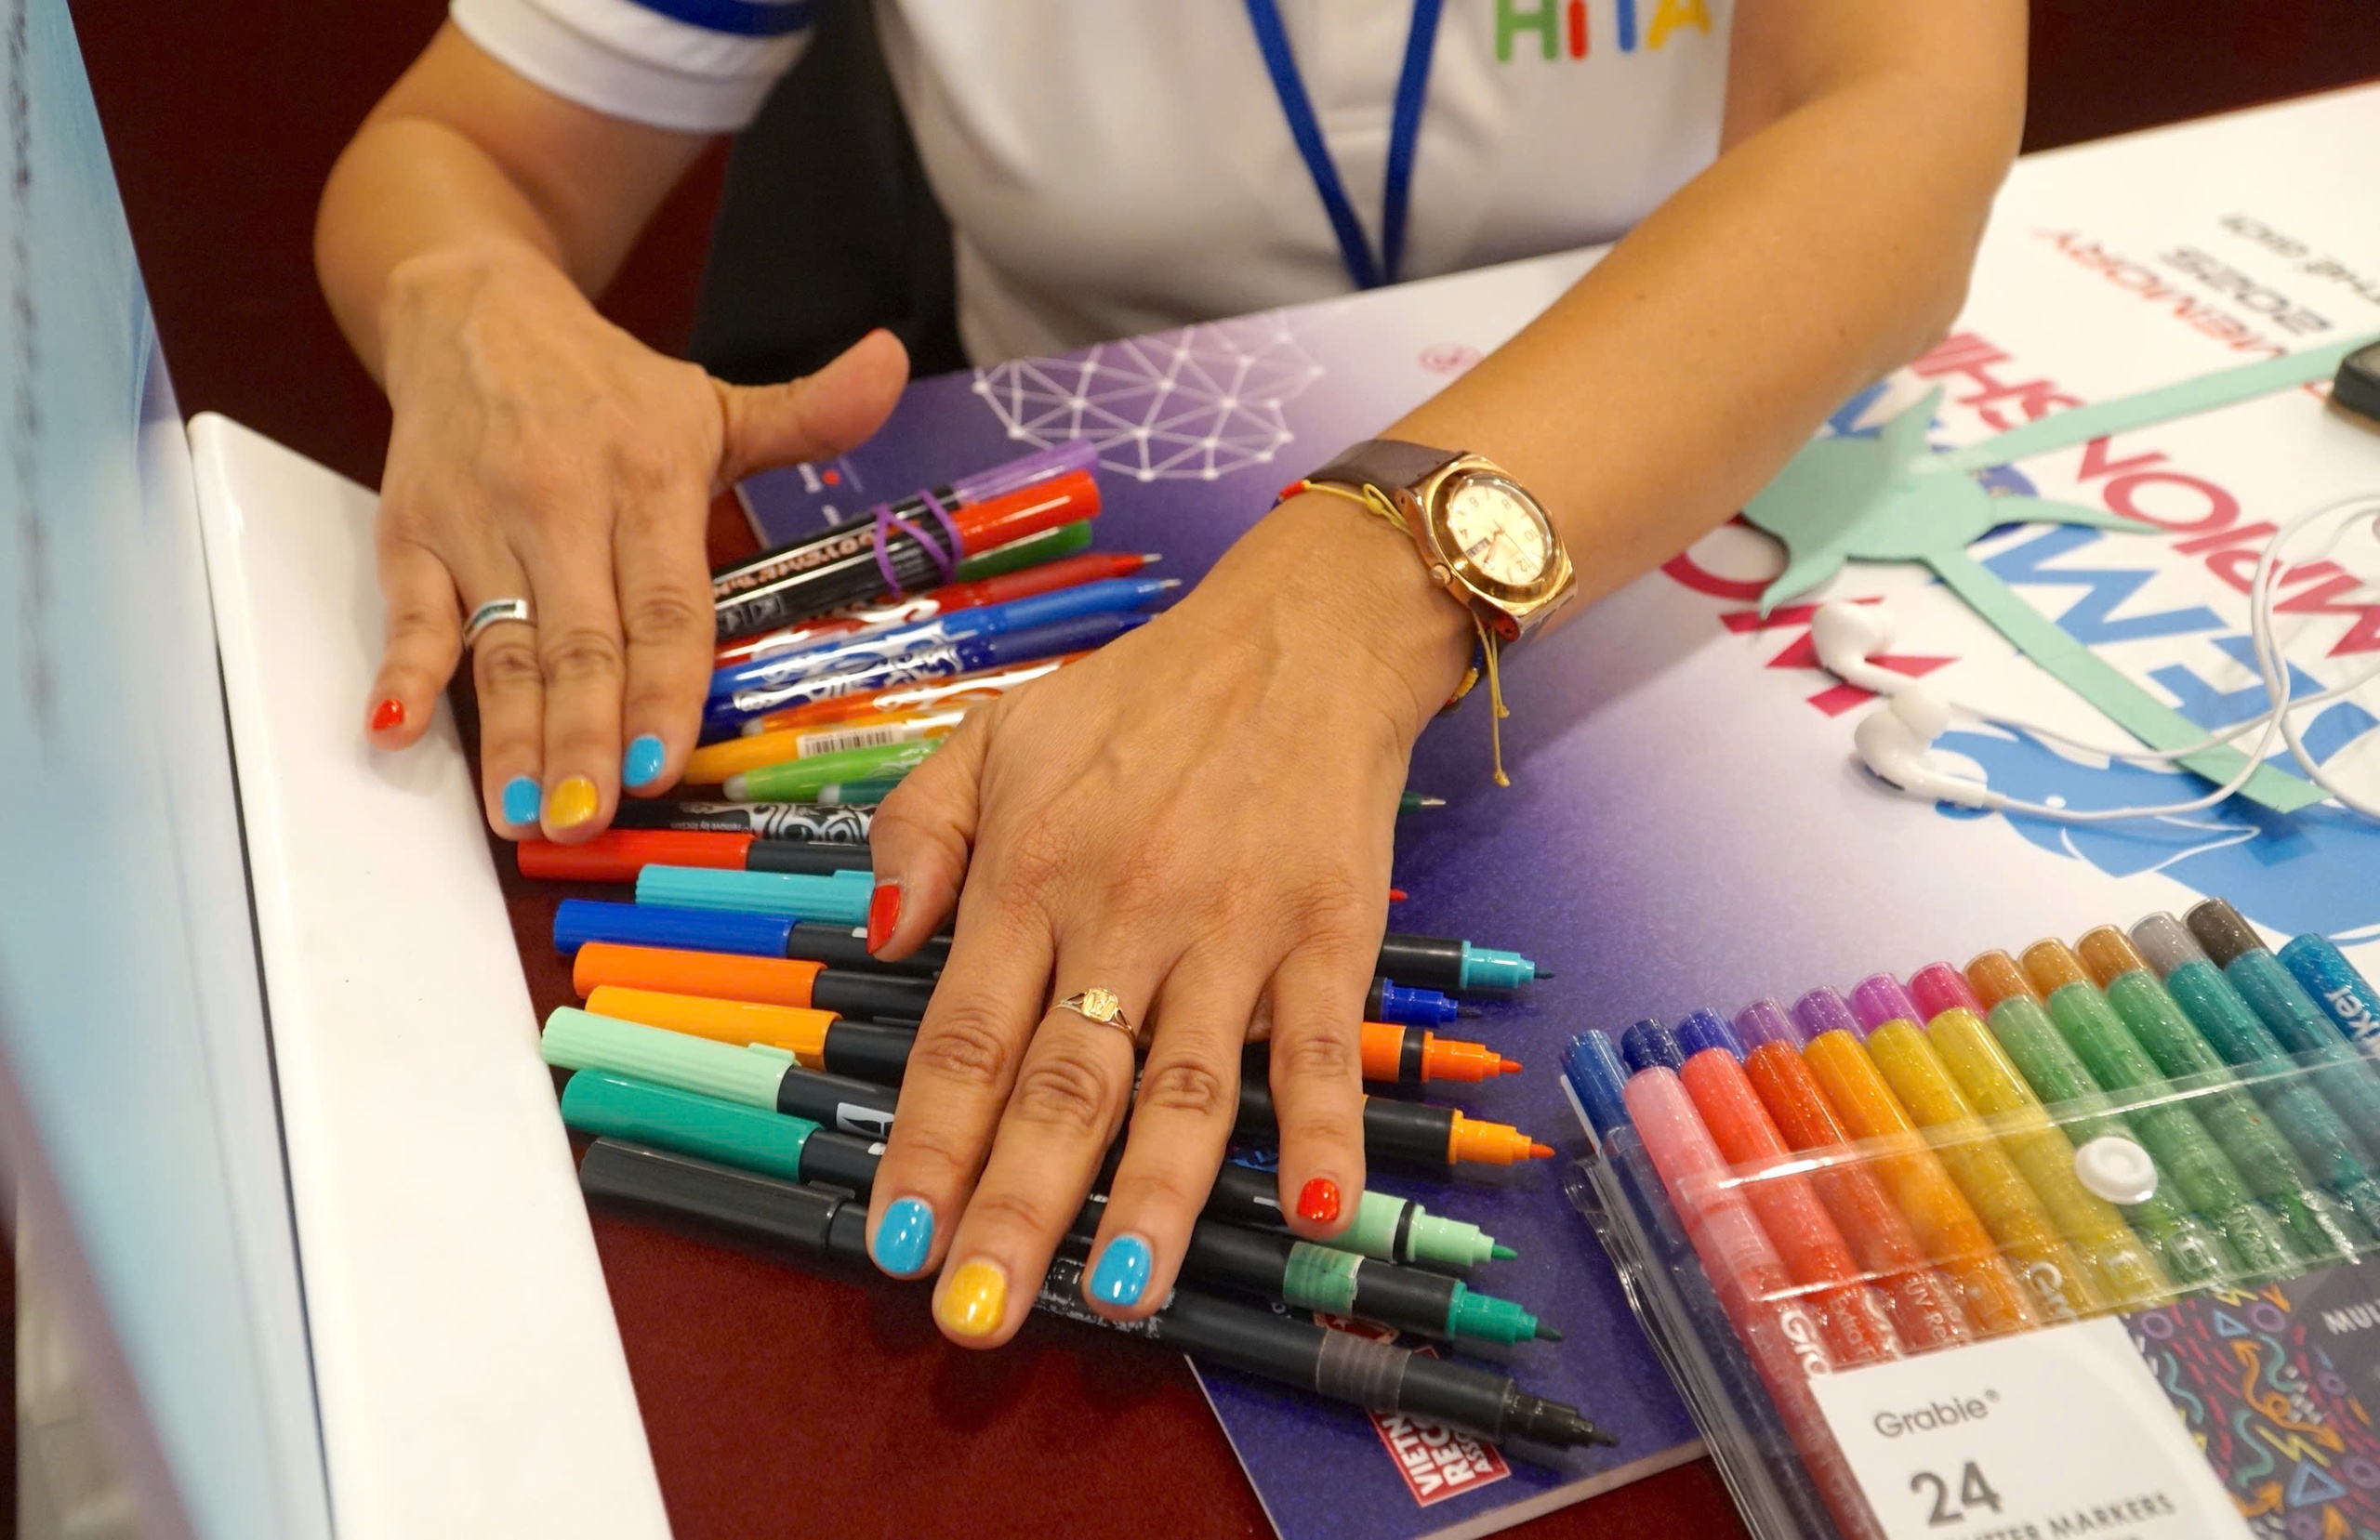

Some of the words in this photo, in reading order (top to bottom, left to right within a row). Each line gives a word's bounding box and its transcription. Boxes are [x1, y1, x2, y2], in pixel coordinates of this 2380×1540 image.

[2159, 245, 2334, 339] 2025
[1382, 1414, 1444, 1496] VIETN
[1911, 1460, 2003, 1528] 24
[2047, 1492, 2176, 1538] MARKERS
